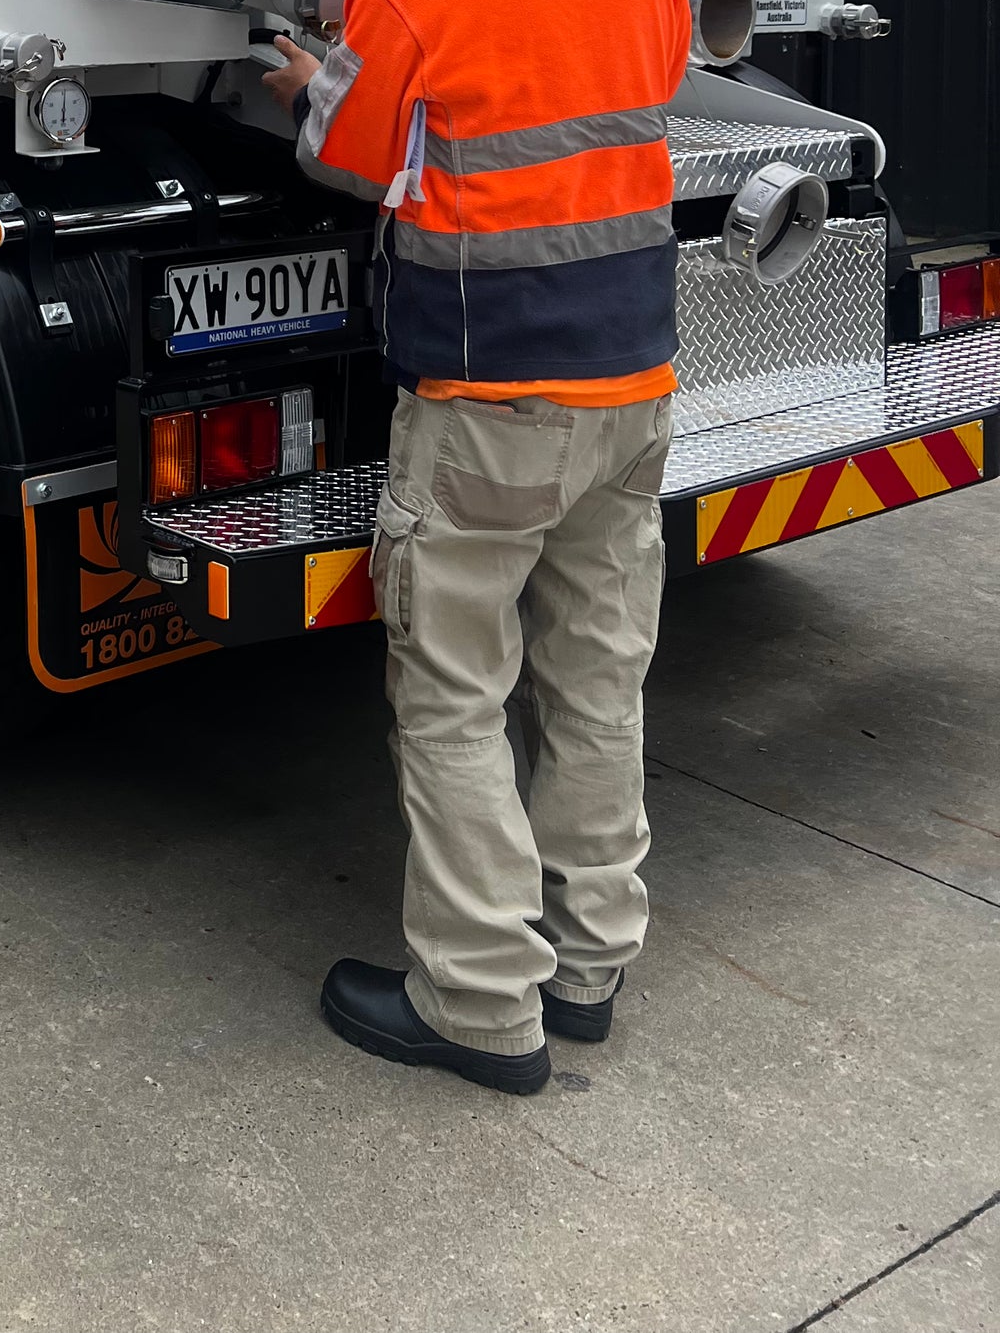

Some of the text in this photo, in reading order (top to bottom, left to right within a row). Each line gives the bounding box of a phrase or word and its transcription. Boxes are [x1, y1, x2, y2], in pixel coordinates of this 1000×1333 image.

[767, 11, 792, 22] Australia
[784, 0, 805, 10] Victoria
[208, 319, 311, 343] NATIONAL HEAVY VEHICLE
[80, 612, 132, 636] QUALITY
[140, 601, 178, 621] INTEG
[80, 623, 157, 669] 1800
